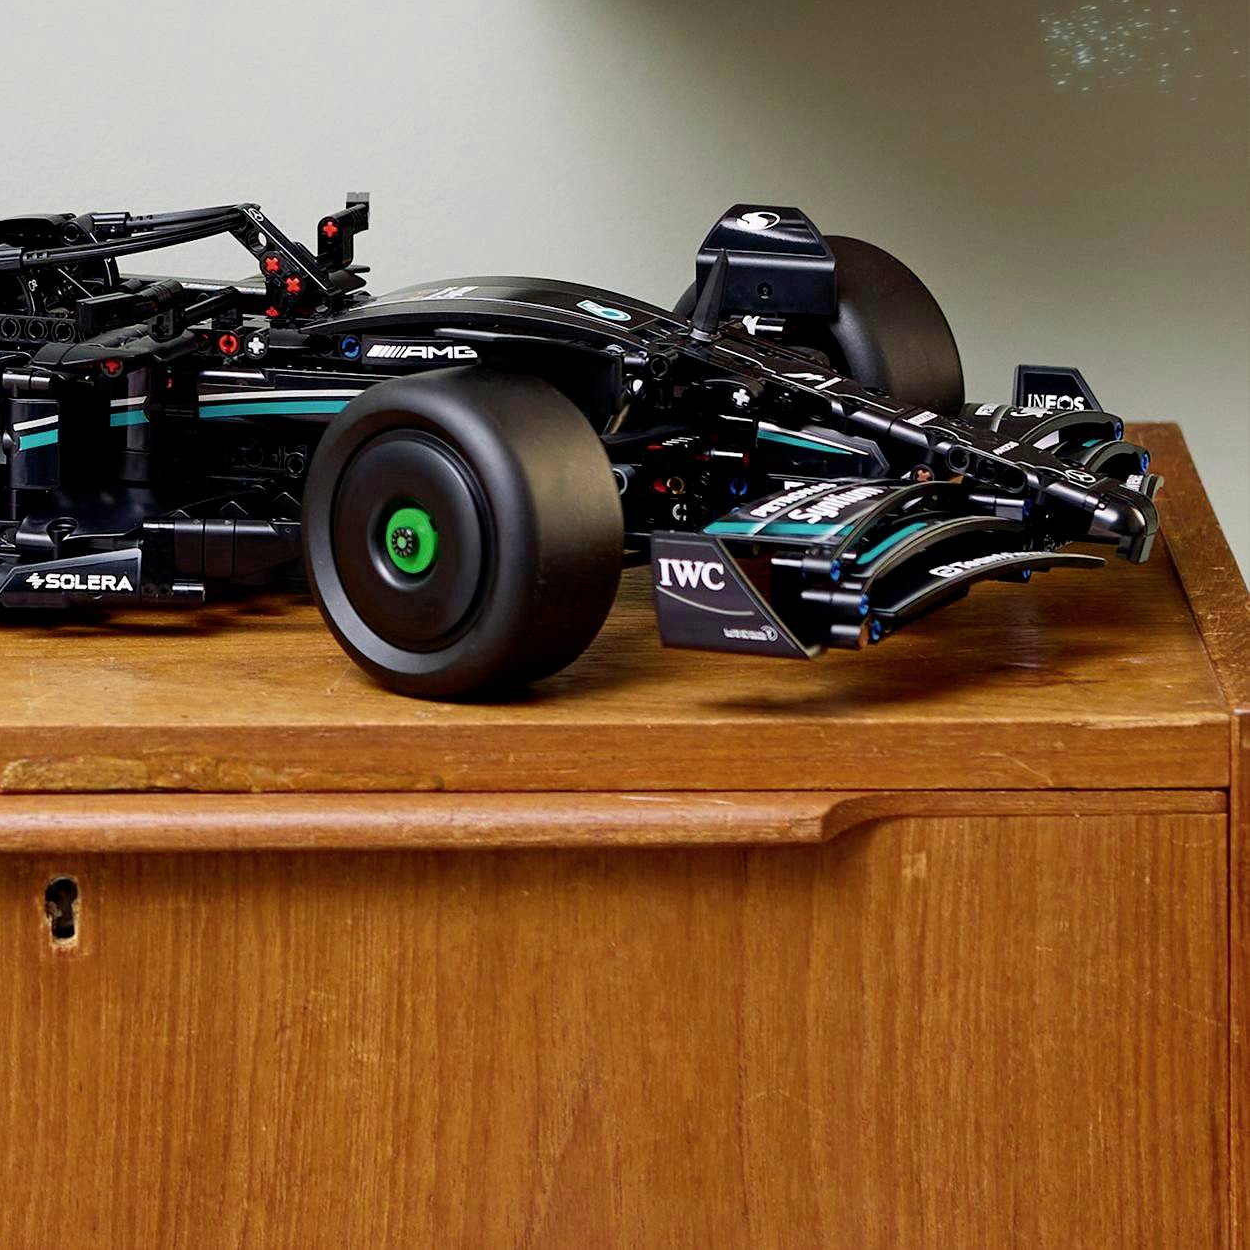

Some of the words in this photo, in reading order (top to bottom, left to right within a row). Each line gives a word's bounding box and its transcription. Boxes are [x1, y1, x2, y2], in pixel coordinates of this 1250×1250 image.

[400, 345, 479, 359] AMG
[1027, 393, 1085, 411] INEOS
[44, 573, 134, 591] SOLERA
[657, 557, 726, 591] IWC
